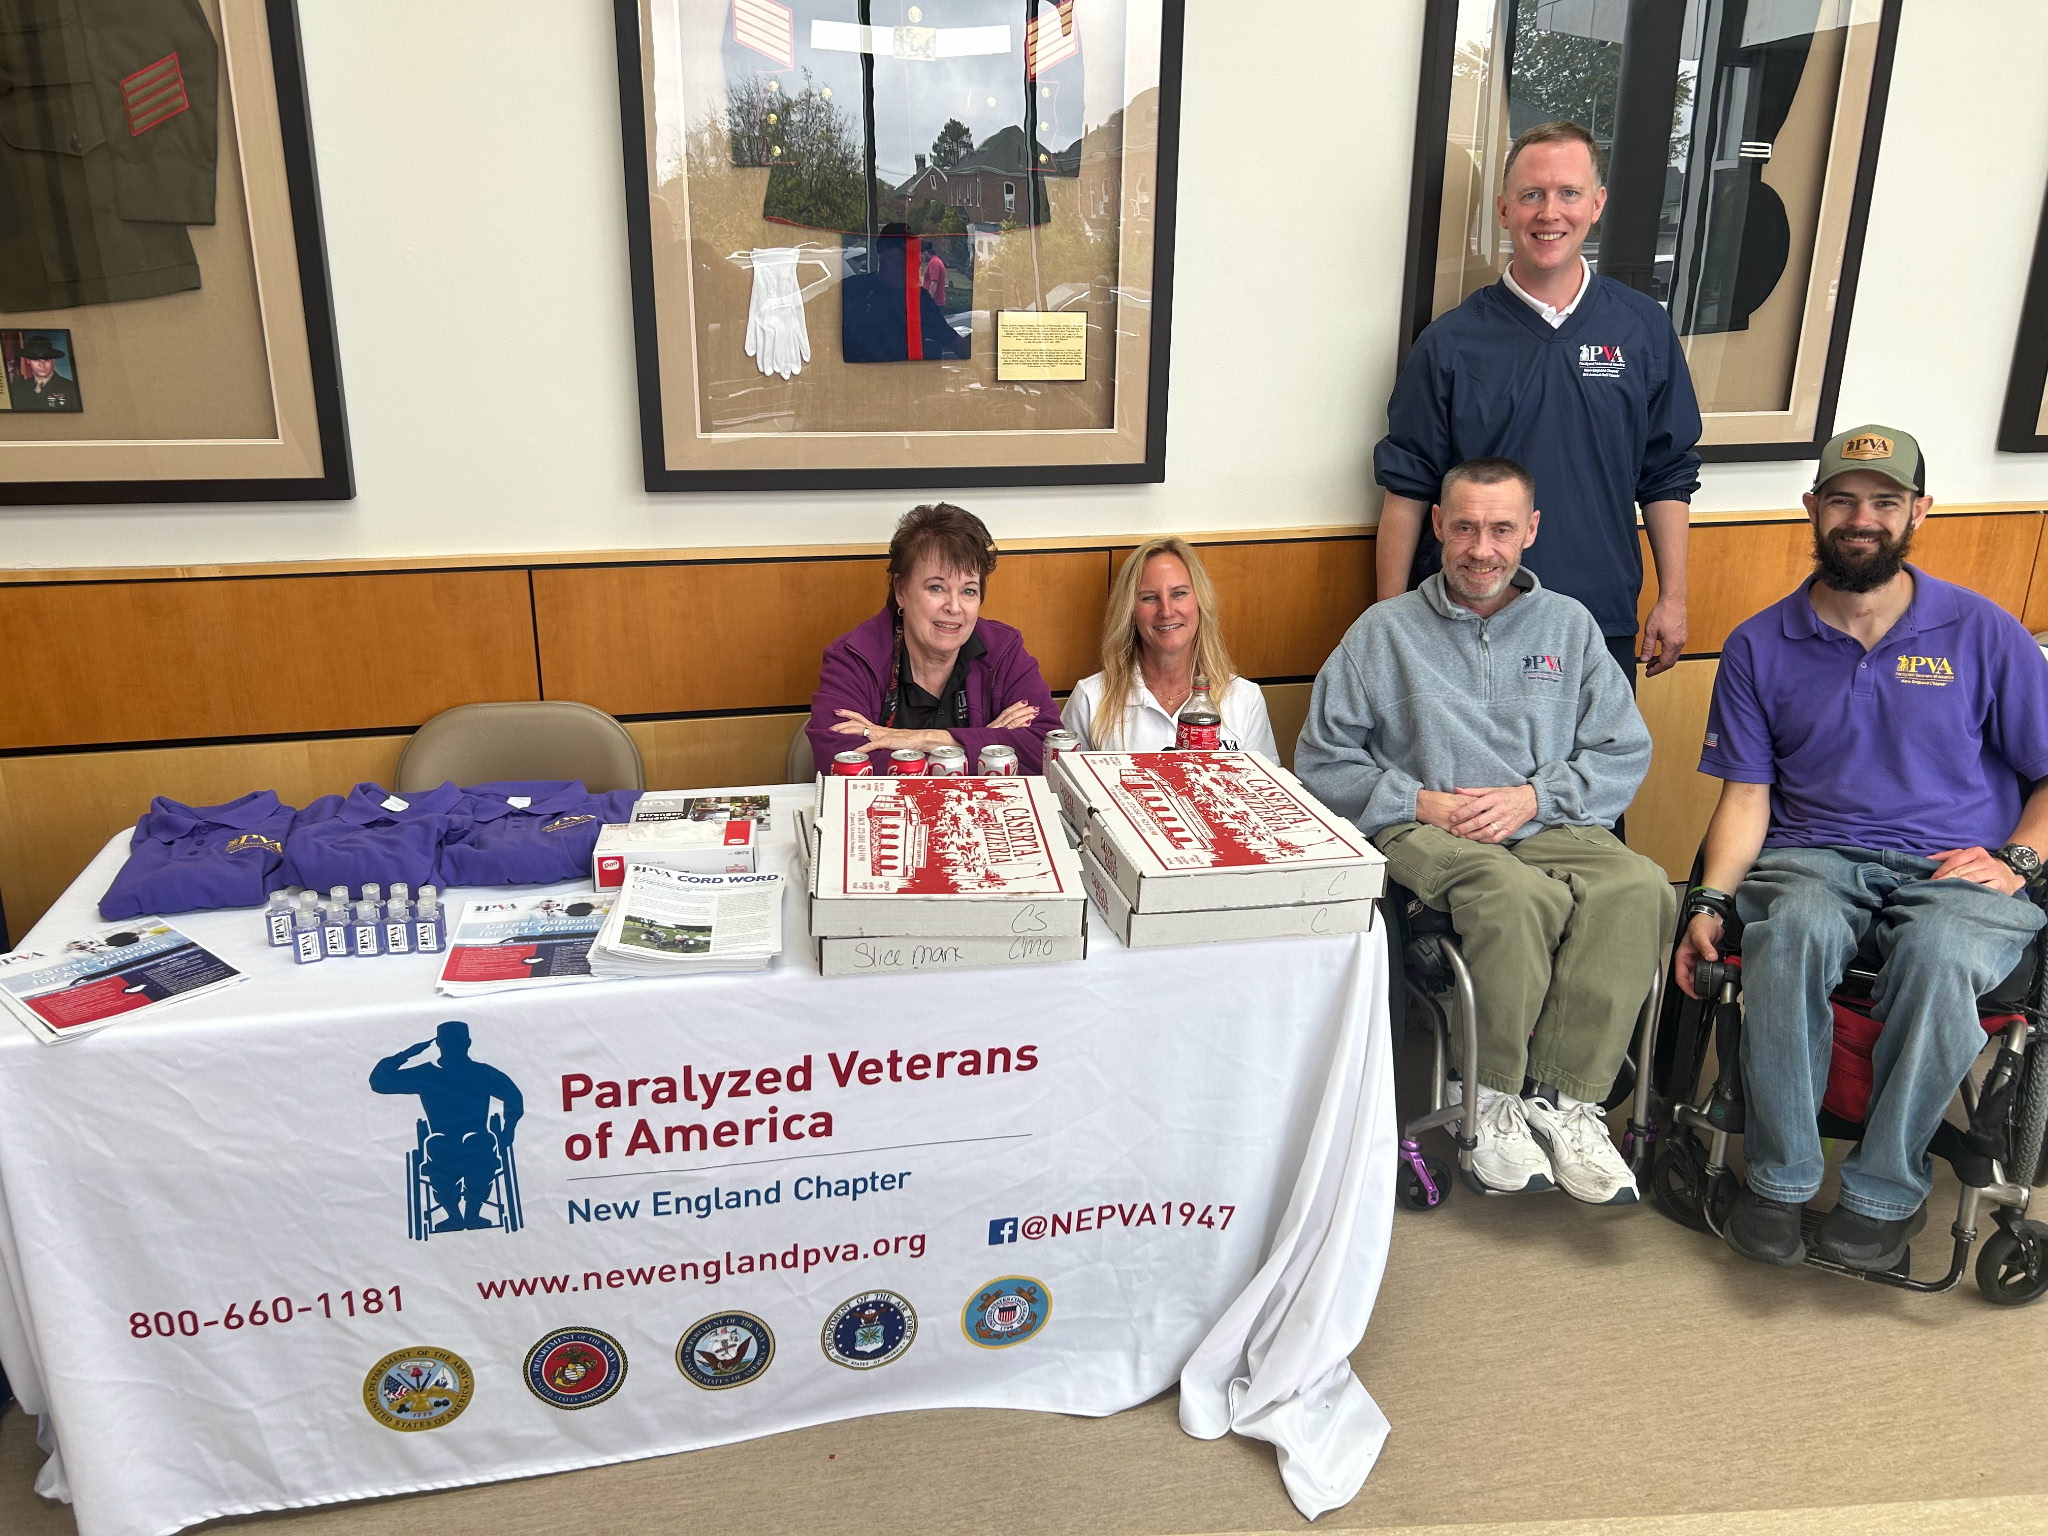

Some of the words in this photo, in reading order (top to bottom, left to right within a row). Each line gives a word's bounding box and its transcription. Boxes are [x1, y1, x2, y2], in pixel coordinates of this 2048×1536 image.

[1589, 346, 1625, 362] PVA
[1855, 438, 1889, 452] PVA
[1531, 655, 1563, 673] PVA
[1908, 656, 1954, 675] PVA
[1236, 792, 1291, 832] PIZZERIA
[1246, 779, 1312, 825] CASERTA
[982, 822, 1013, 864] PIZZERIA
[1002, 807, 1042, 858] CASERTA
[642, 866, 671, 878] PVA
[677, 875, 724, 884] CORD
[728, 874, 779, 884] WORD
[484, 903, 517, 911] PVA
[486, 920, 535, 930] Career
[541, 917, 599, 927] Support
[503, 928, 533, 936] ALL
[31, 959, 90, 979] Career
[93, 938, 157, 961] Support
[31, 976, 56, 986] for
[63, 966, 98, 980] ALL
[98, 943, 171, 968] Veterans
[853, 942, 904, 969] Slice
[561, 1054, 812, 1112] Paralyzed
[827, 1044, 1039, 1088] Veterans
[564, 1120, 613, 1161] of
[624, 1105, 833, 1157] America
[567, 1198, 640, 1225] New
[652, 1180, 781, 1219] England
[793, 1170, 912, 1201] Chapter
[1021, 1201, 1236, 1240] @NEPVA1947
[476, 1233, 927, 1300] www.newenglandpva.org
[129, 1285, 402, 1339] 800-660-1181
[825, 1304, 853, 1351] DEPARTMENT
[856, 1295, 869, 1304] OF
[874, 1293, 893, 1301] THE
[894, 1300, 908, 1313] AIR
[904, 1315, 915, 1341] FORCE
[533, 1334, 575, 1372] DEPARTMENT
[588, 1336, 600, 1345] THE
[603, 1344, 618, 1363] NAVY
[685, 1320, 723, 1353] DEPARTMENT
[740, 1320, 754, 1329] THE
[368, 1351, 411, 1392] DEPARTMENT
[434, 1351, 451, 1361] THE
[451, 1360, 469, 1382] ARMY
[369, 1396, 393, 1423] UNITED
[394, 1420, 432, 1429] STATES
[434, 1417, 446, 1425] OF
[446, 1383, 470, 1418] AMERICA
